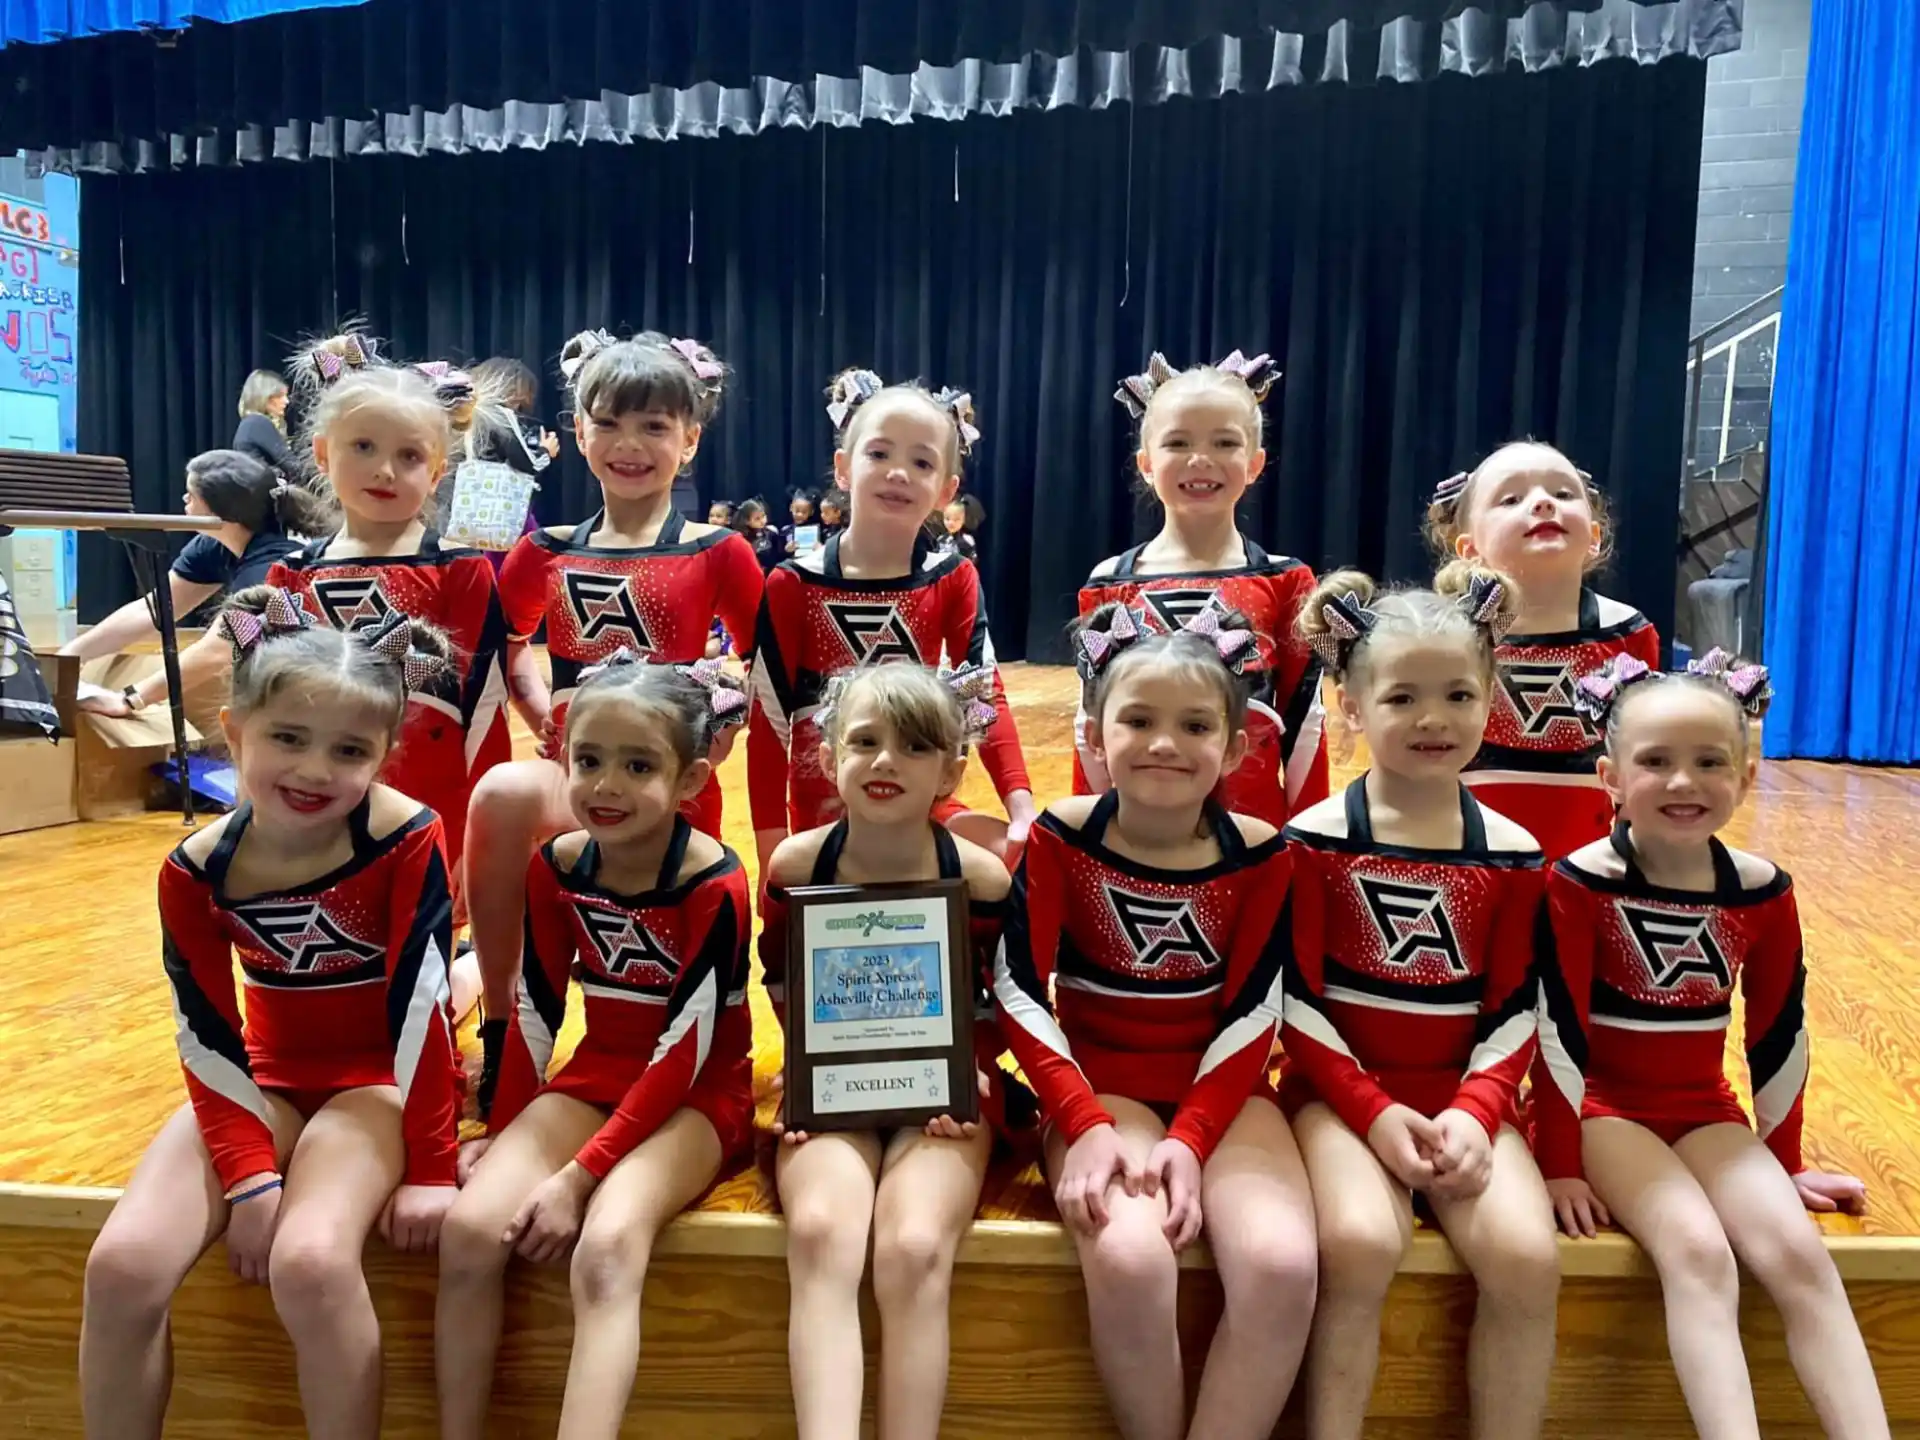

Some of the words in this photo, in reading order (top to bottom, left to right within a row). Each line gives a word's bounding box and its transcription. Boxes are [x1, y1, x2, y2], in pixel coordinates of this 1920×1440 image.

[564, 568, 657, 652] FA
[233, 903, 386, 974] FA
[573, 903, 680, 978] FA
[862, 954, 890, 967] 2023
[1104, 883, 1222, 968] FA
[1353, 872, 1469, 976] FA
[1616, 899, 1732, 991] FA
[816, 991, 873, 1006] Asheville
[876, 987, 939, 1003] Challenge
[837, 972, 872, 988] Spirit
[875, 971, 917, 985] Xpress
[845, 1076, 915, 1092] EXCELLENT
